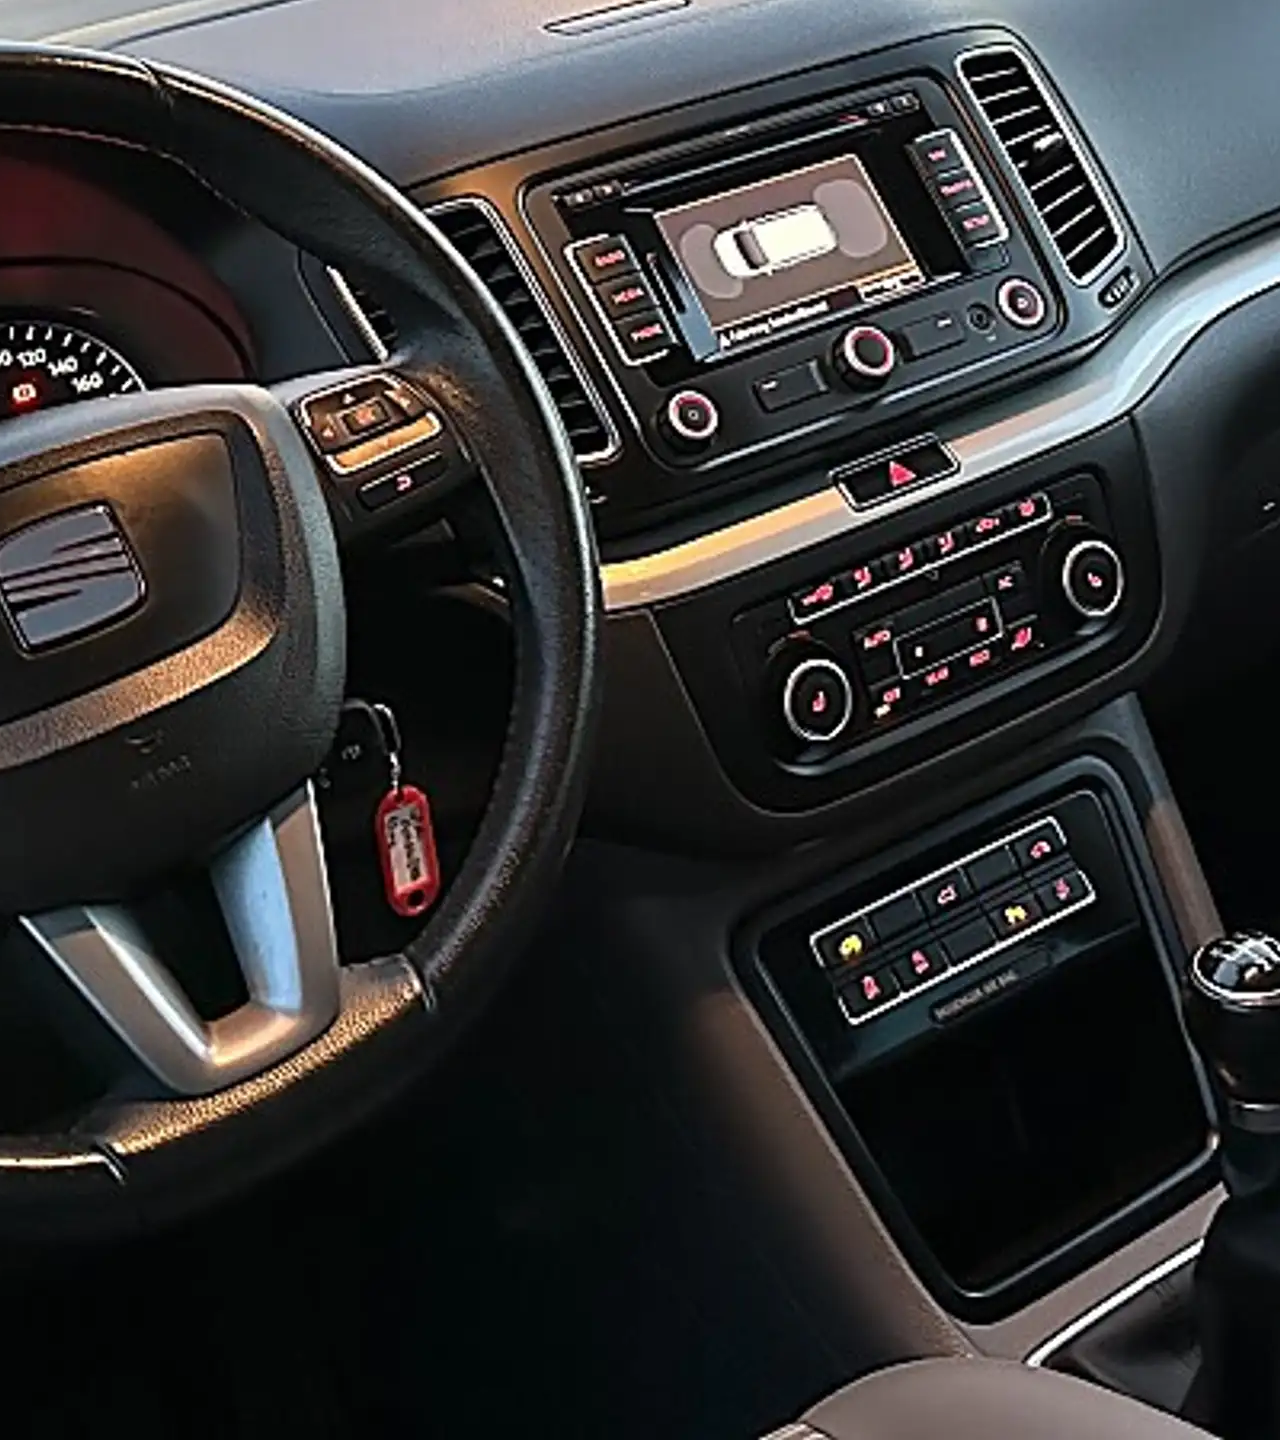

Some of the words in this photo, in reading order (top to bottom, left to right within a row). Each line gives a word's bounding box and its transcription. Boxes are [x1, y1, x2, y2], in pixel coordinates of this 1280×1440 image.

[17, 347, 47, 367] 120
[48, 356, 78, 377] 140
[71, 371, 103, 393] 160
